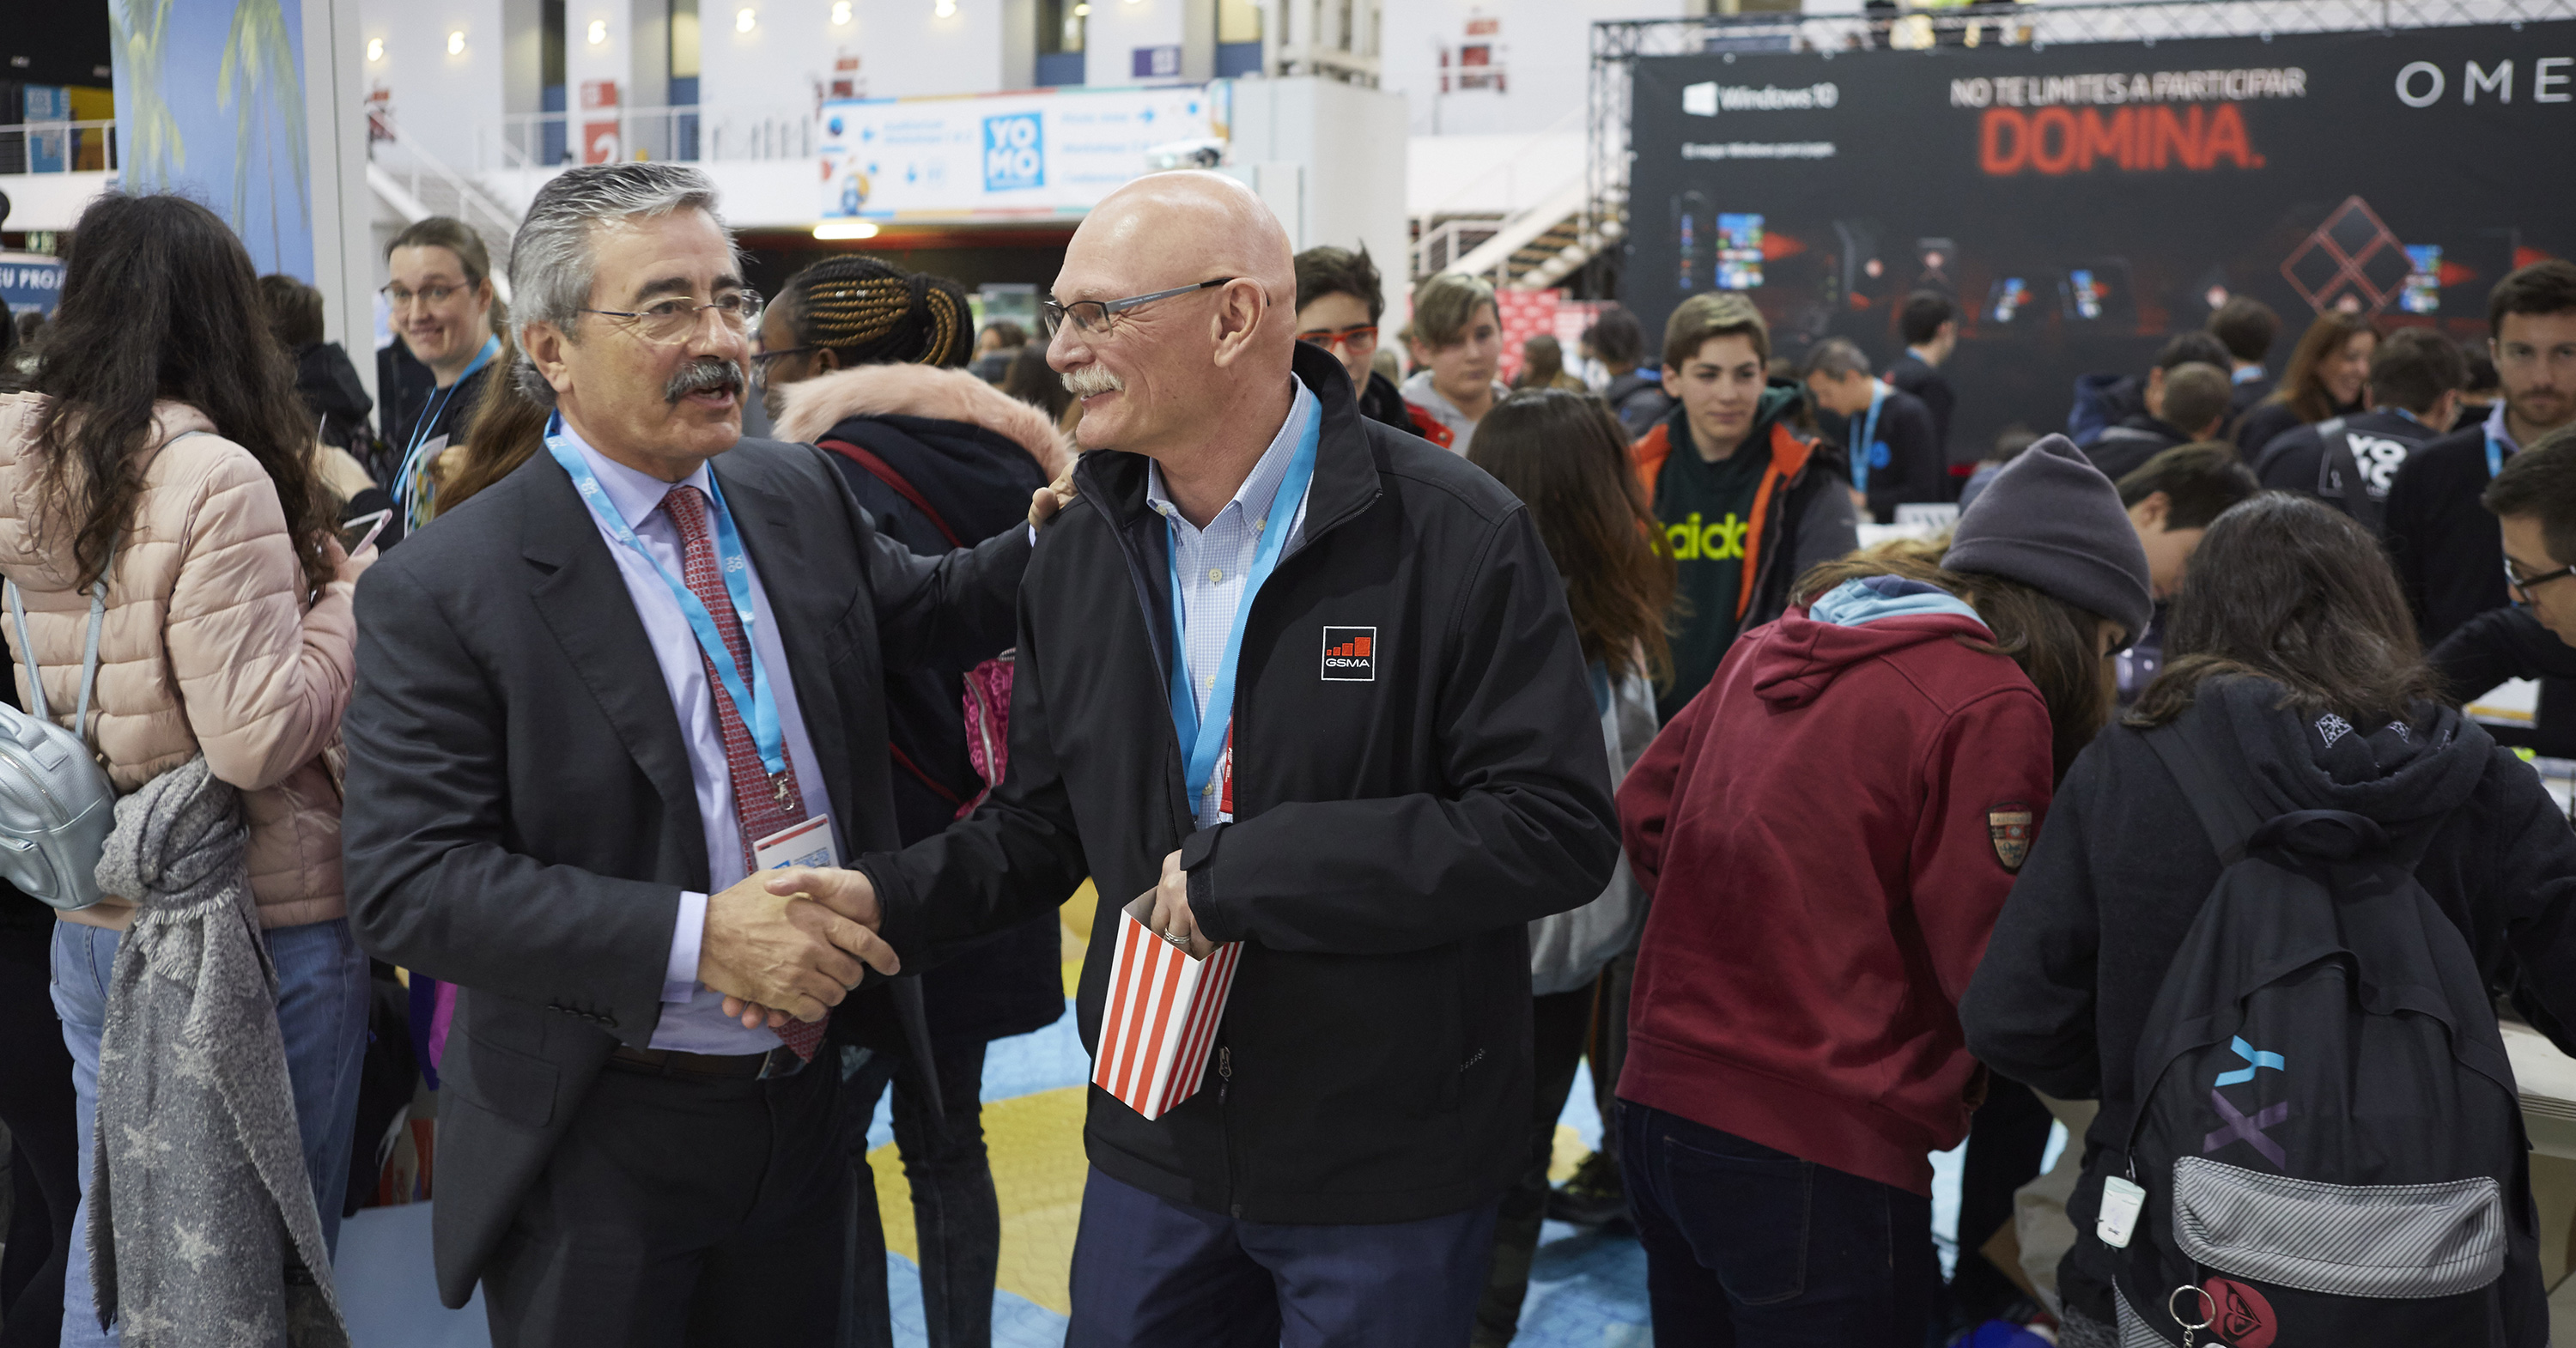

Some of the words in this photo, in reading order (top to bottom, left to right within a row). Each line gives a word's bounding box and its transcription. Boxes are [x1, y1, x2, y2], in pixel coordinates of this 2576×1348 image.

[1718, 83, 1813, 110] Windows
[1813, 82, 1839, 109] 10
[1950, 76, 1992, 108] NO
[1992, 76, 2027, 107] TE
[2028, 71, 2129, 106] LIMITES
[2129, 72, 2152, 103] A
[2151, 67, 2306, 102] PARTICIPAR
[2395, 57, 2574, 108] OME
[989, 118, 1036, 149] YO
[1980, 105, 2266, 174] DOMINA.
[987, 149, 1039, 178] MO
[2346, 433, 2407, 465] YO
[1325, 658, 1370, 668] GSMA
